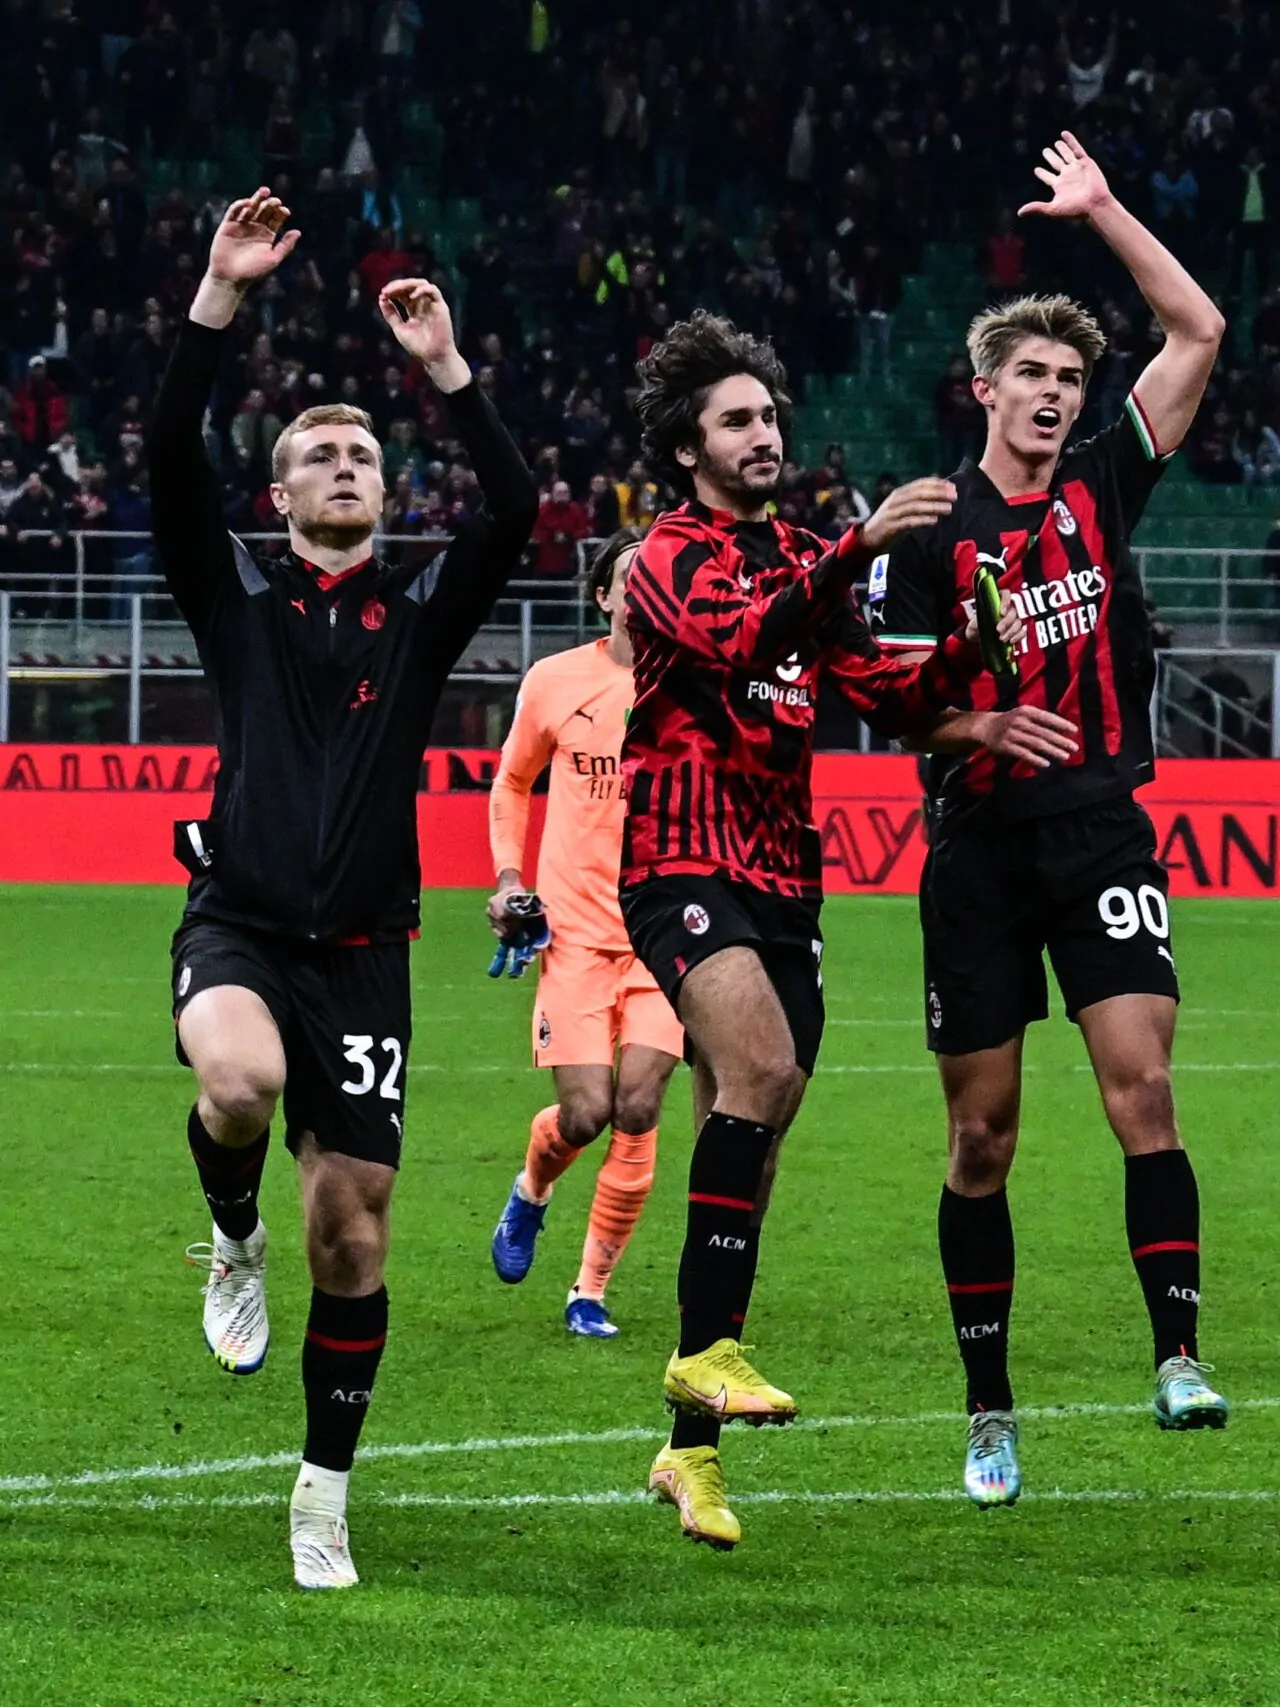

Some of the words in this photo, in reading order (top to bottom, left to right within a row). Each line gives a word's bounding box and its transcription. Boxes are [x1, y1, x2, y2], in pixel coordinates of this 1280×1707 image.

[1035, 603, 1098, 649] BETTER
[590, 780, 614, 799] FLY
[1098, 884, 1169, 940] 90
[341, 1034, 402, 1101] 32
[960, 1321, 1000, 1340] ACM
